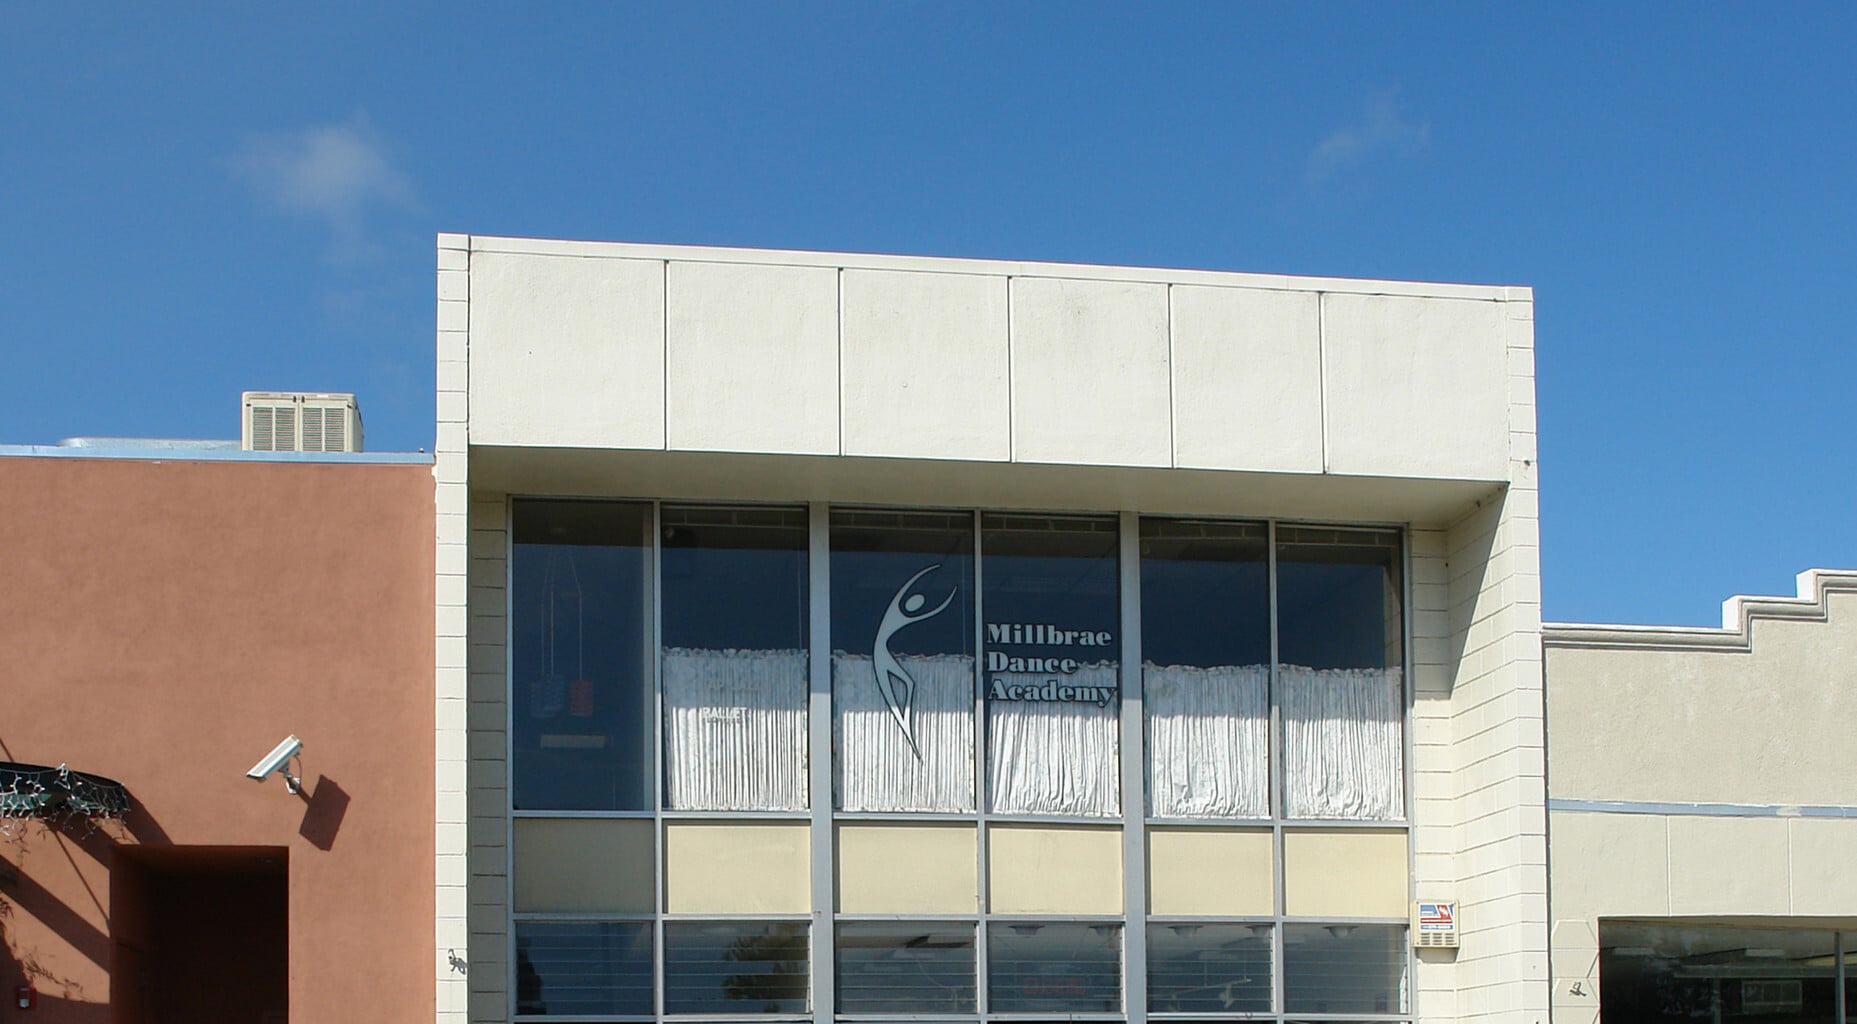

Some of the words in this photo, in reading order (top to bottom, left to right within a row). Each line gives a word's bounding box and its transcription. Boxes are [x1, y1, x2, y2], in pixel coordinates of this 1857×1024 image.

[987, 623, 1112, 646] Millbrae
[987, 651, 1077, 674] Dance
[988, 679, 1117, 707] Academy
